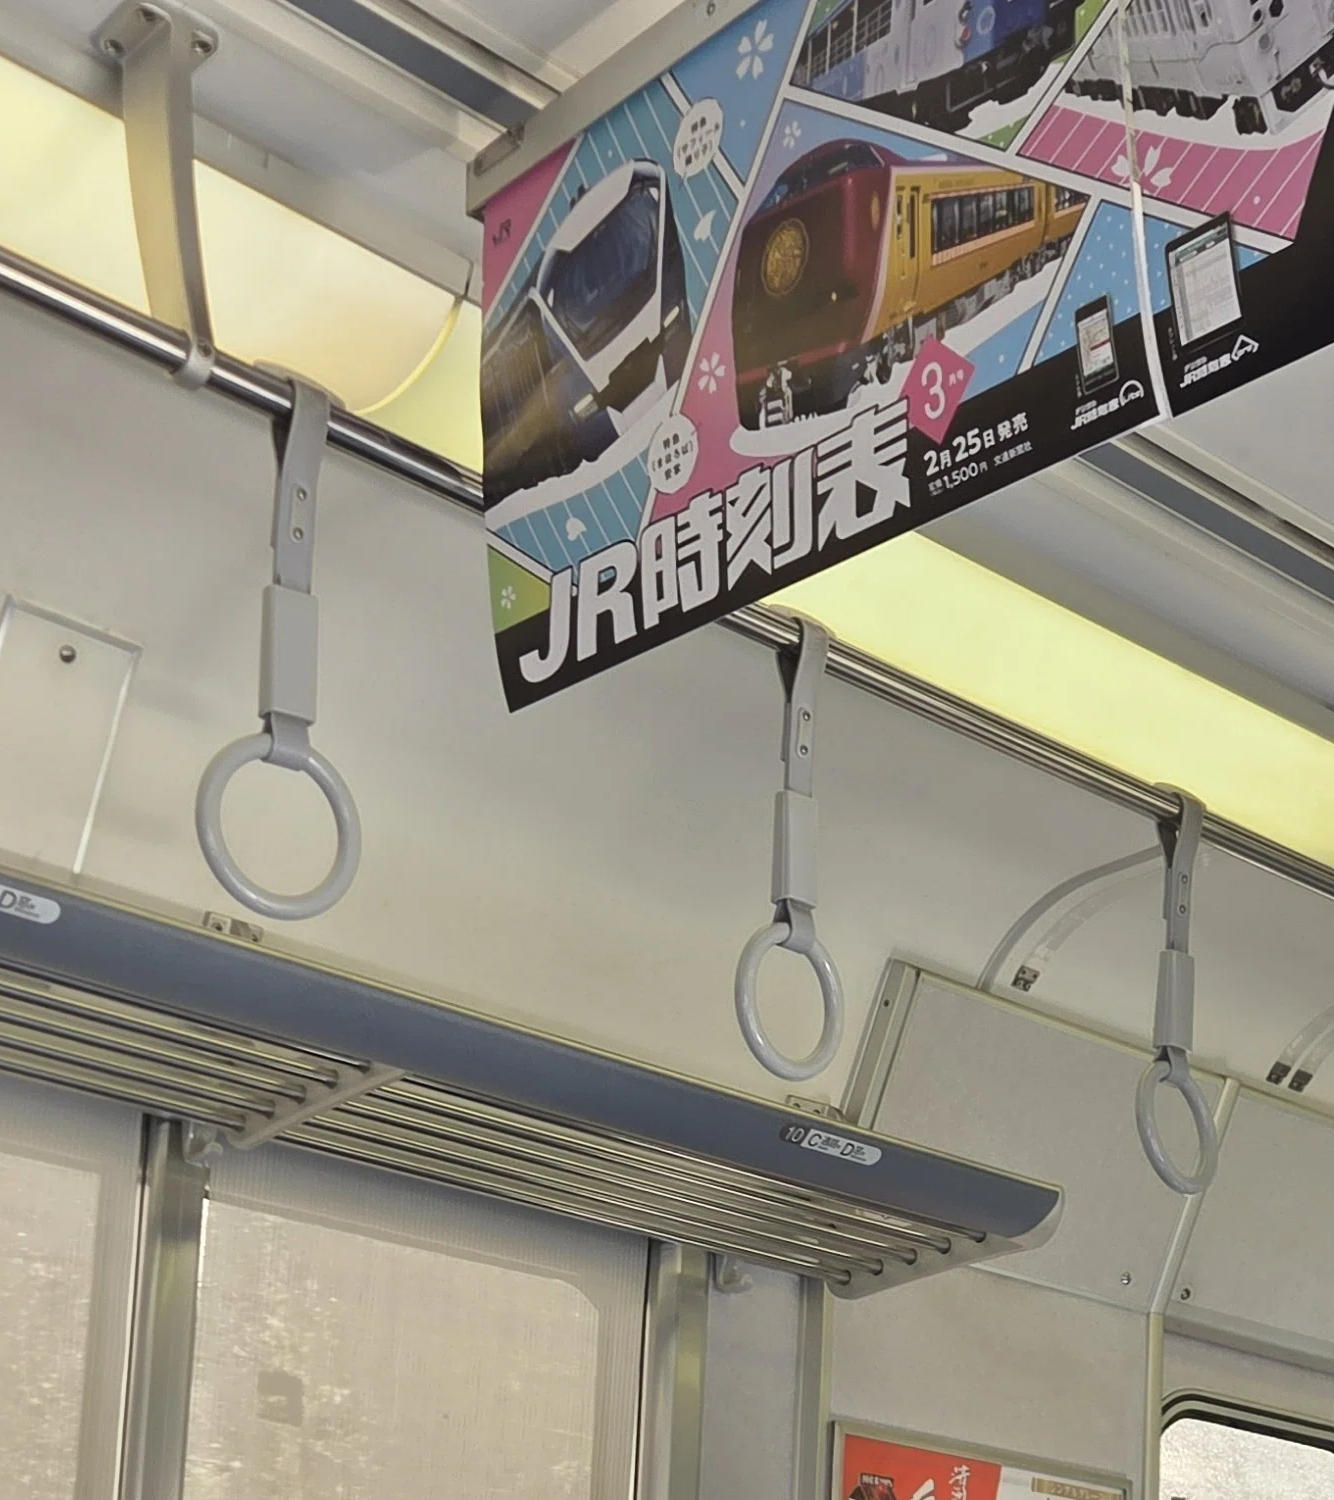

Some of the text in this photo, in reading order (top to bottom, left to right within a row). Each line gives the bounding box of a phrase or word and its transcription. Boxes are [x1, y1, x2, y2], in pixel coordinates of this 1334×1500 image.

[923, 412, 1029, 477] 2月25日発売
[518, 398, 911, 684] JR時刻表
[784, 1126, 805, 1143] 10
[807, 1133, 822, 1148] C
[839, 1142, 855, 1157] D
